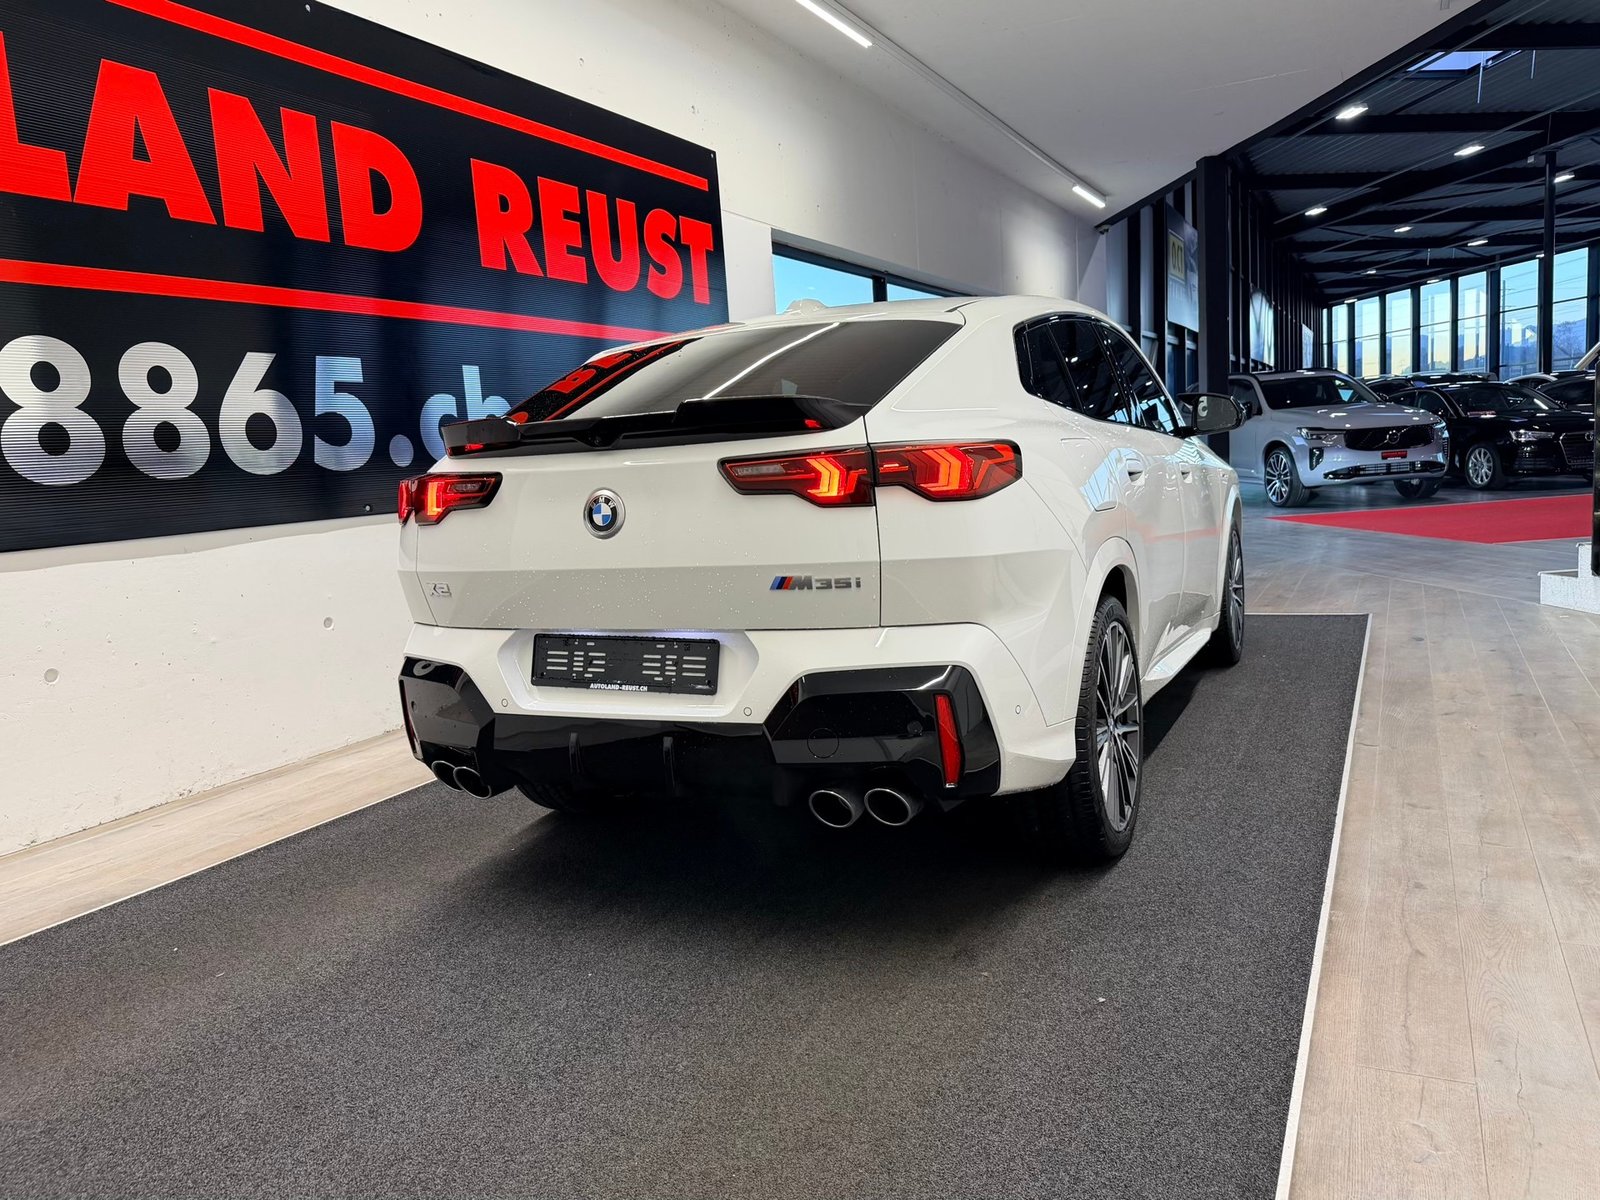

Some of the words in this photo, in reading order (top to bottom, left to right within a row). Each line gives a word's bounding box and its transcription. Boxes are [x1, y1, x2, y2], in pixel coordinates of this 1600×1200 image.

[0, 29, 423, 253] LAND
[470, 157, 714, 305] REUST
[0, 334, 512, 486] 8865.ch
[788, 575, 861, 590] M35i
[590, 683, 648, 692] AUTOLAND-REUST.CH
